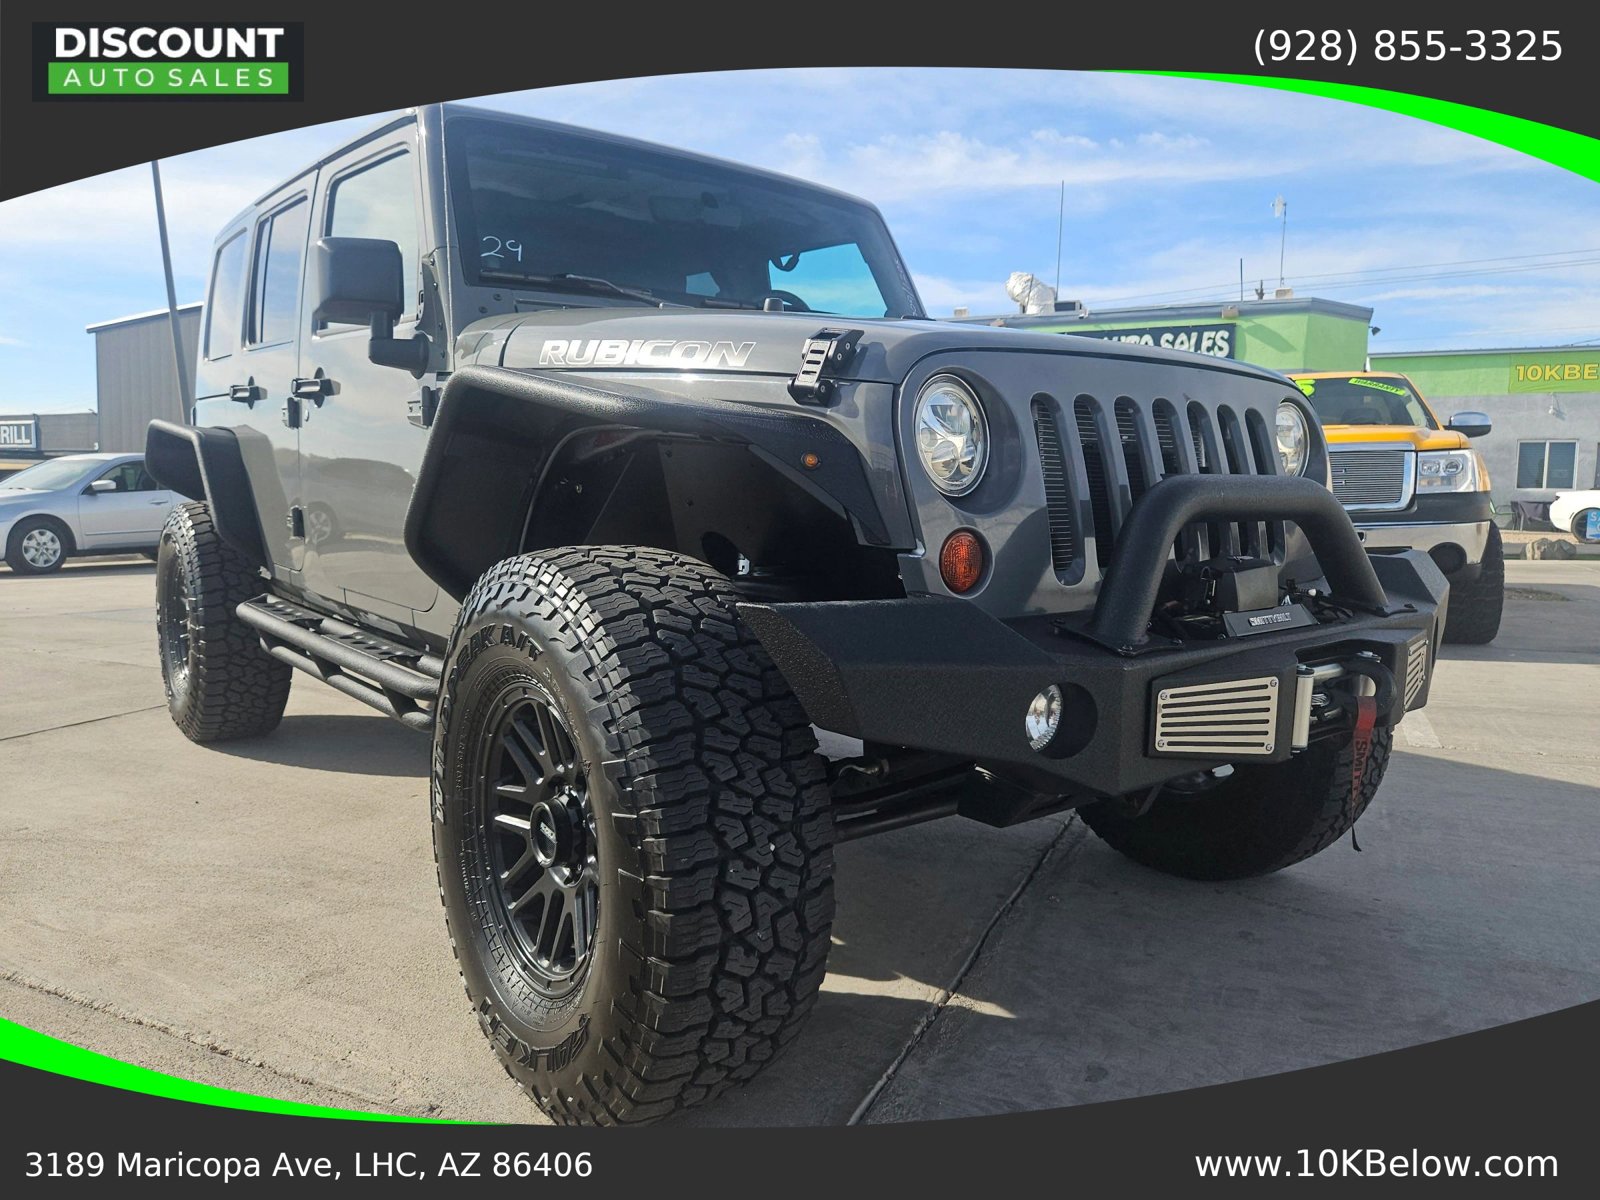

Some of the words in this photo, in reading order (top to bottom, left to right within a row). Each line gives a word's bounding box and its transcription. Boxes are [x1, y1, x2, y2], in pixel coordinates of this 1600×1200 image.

[480, 235, 523, 262] 29
[538, 339, 757, 367] RUBICON
[1160, 329, 1230, 358] SALES
[1516, 363, 1599, 381] 10KBE
[0, 425, 31, 444] RILL
